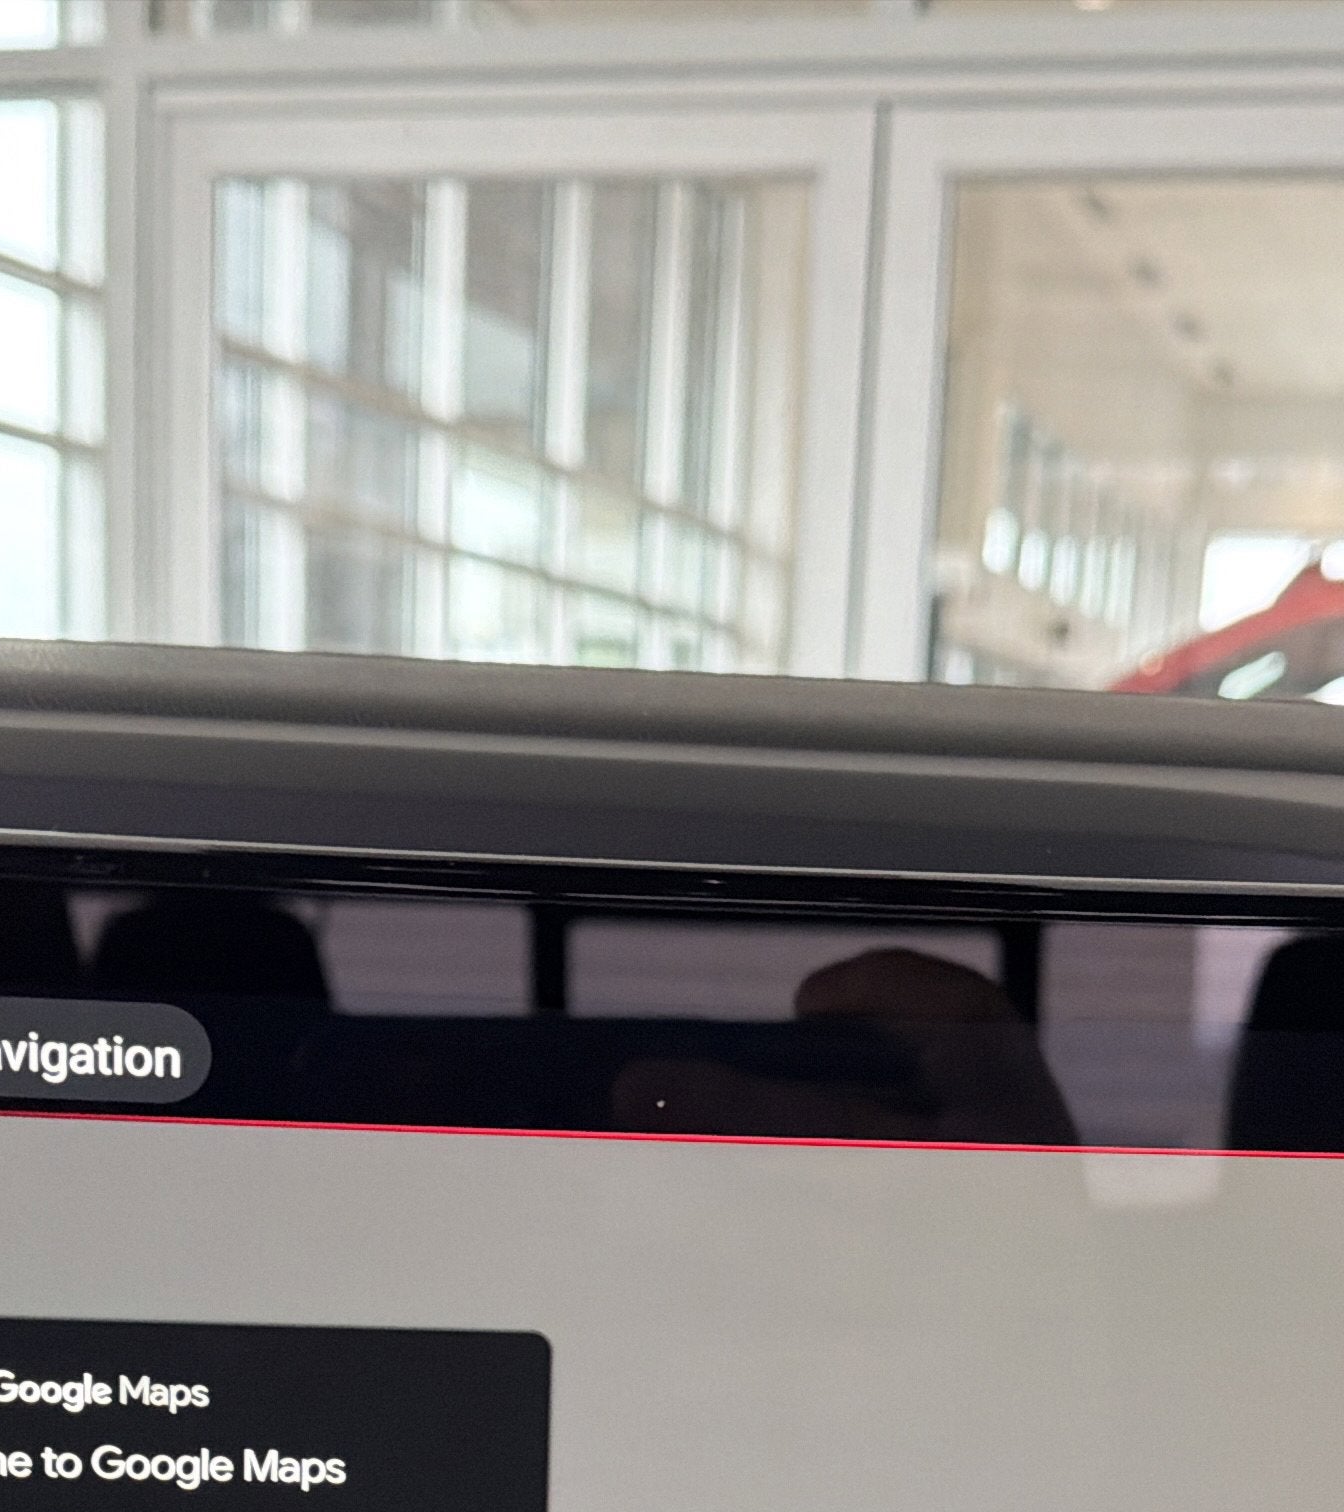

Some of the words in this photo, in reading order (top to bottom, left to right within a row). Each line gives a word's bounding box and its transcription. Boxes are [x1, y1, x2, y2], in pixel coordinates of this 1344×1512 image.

[119, 1375, 209, 1414] Maps
[41, 1447, 82, 1478] to
[91, 1445, 234, 1490] Google
[244, 1449, 346, 1492] Maps
